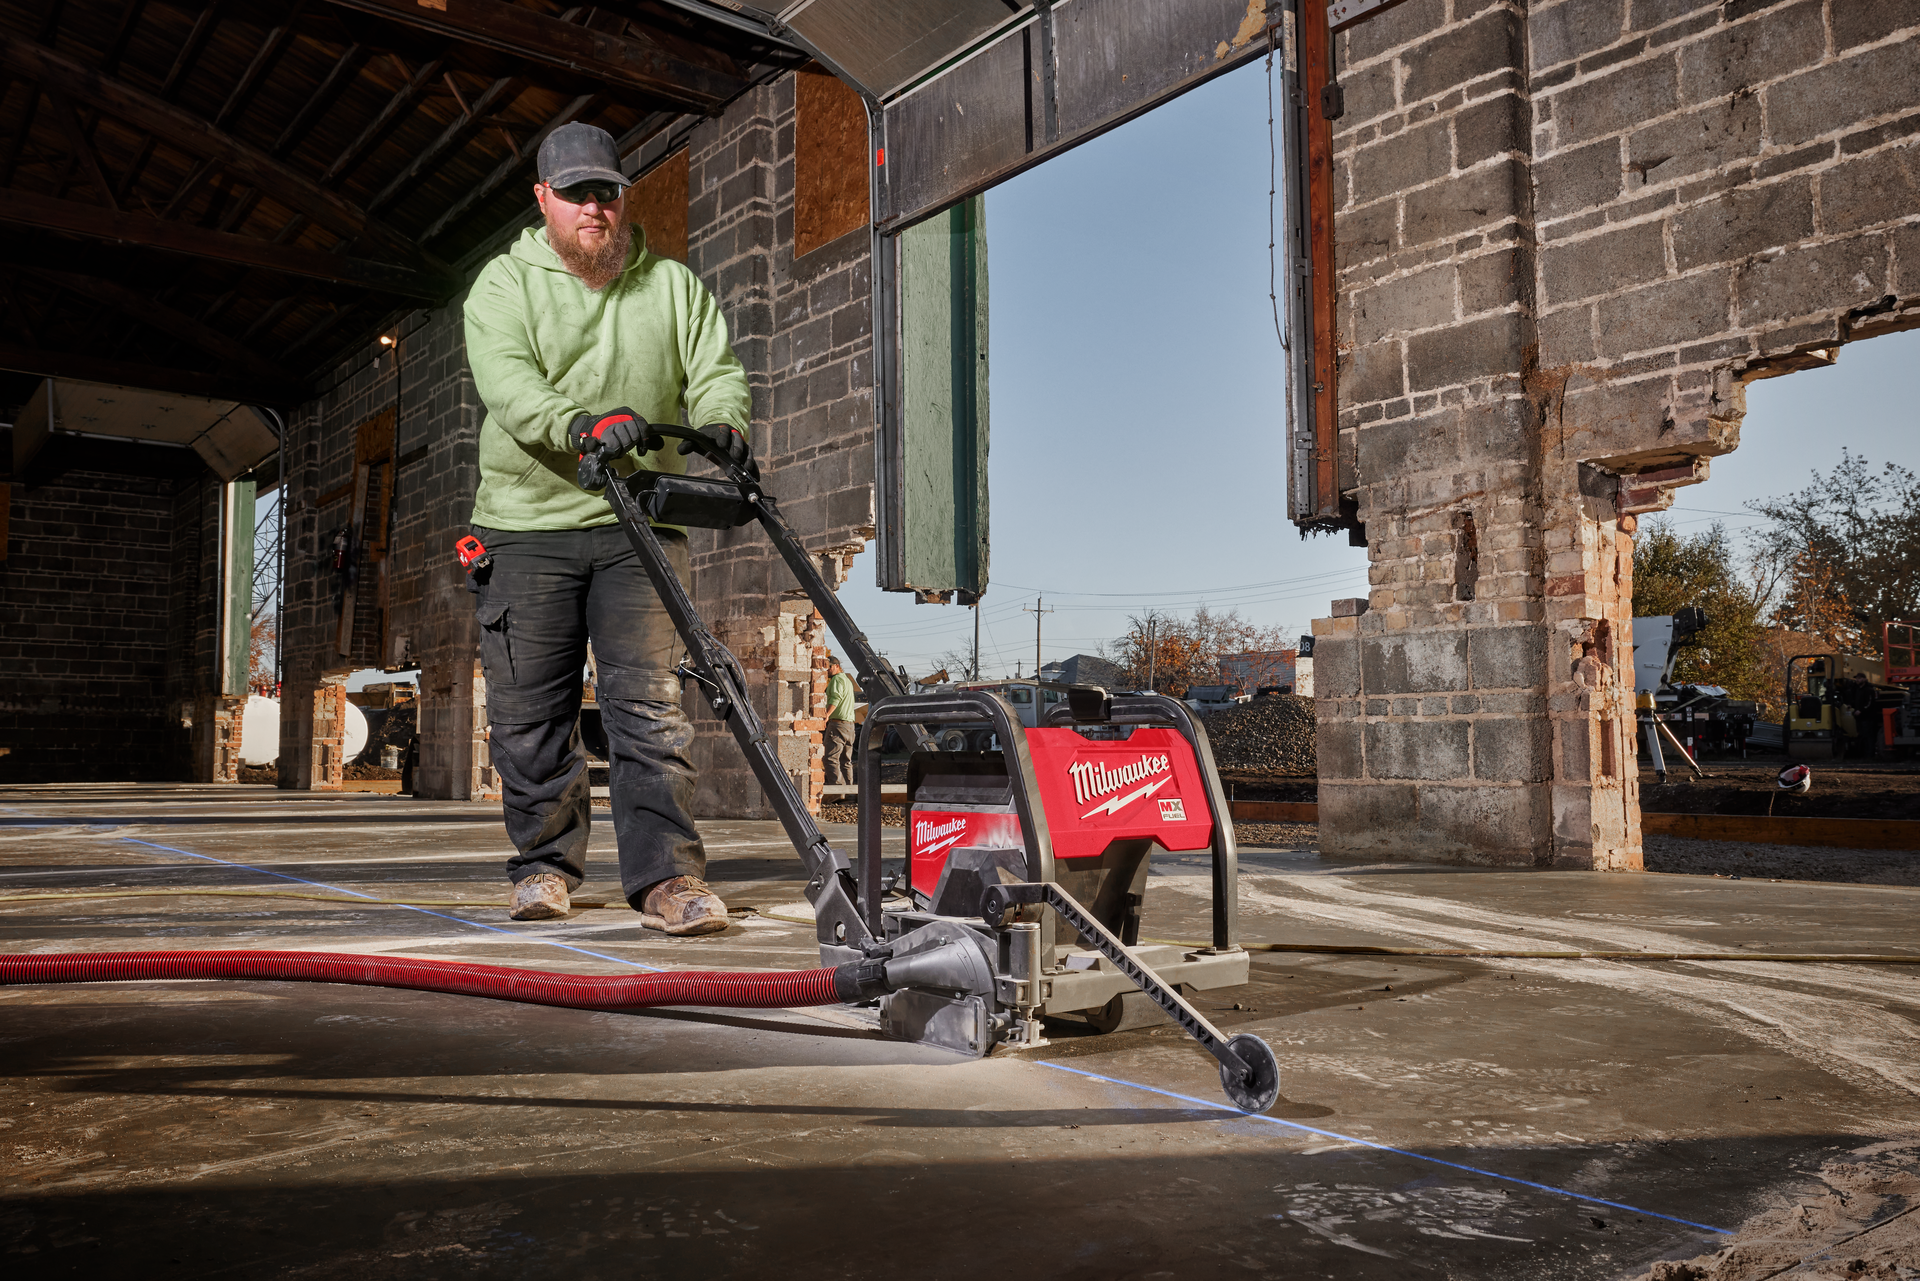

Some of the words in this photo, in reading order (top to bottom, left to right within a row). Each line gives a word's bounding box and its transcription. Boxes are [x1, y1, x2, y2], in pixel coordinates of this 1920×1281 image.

[1069, 754, 1169, 805] Milwaukee
[1160, 801, 1182, 812] MX
[916, 818, 966, 846] Milwaukee
